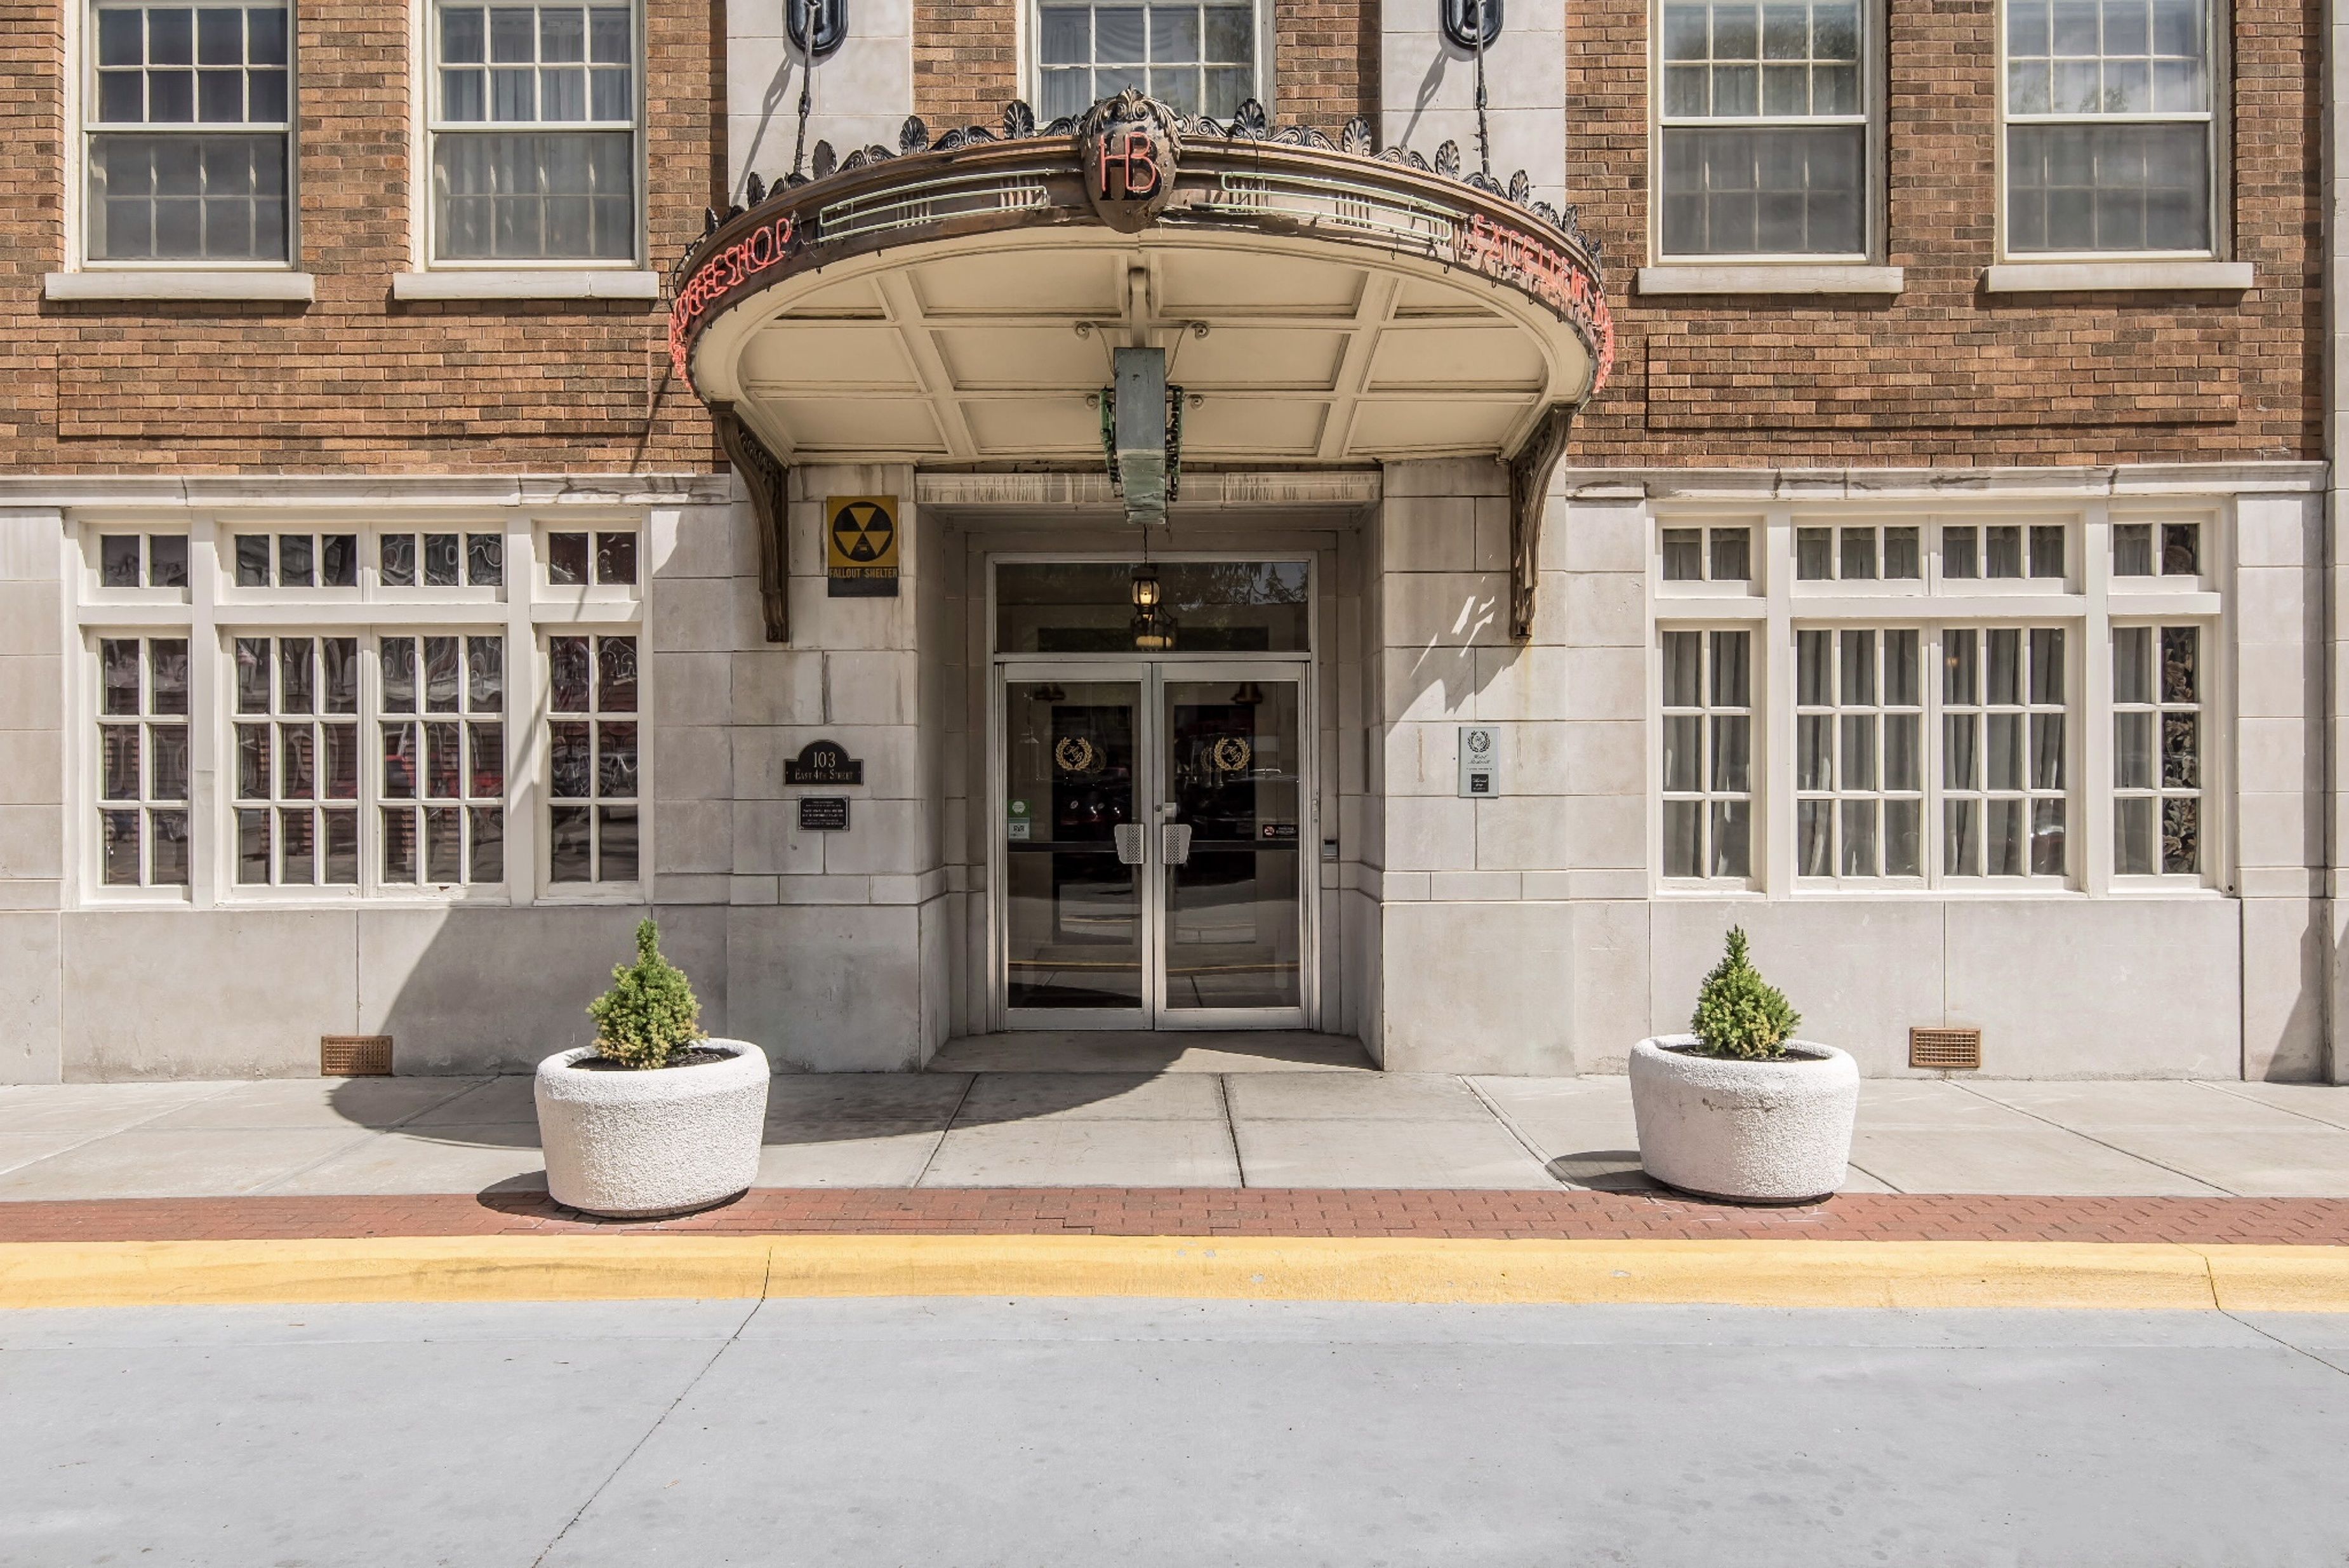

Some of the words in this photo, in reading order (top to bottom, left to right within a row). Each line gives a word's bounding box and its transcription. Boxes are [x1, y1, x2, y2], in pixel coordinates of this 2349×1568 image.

[1099, 126, 1163, 201] HB
[828, 568, 862, 578] FALLOUT
[863, 568, 897, 578] SHELTER
[813, 752, 836, 768] 103
